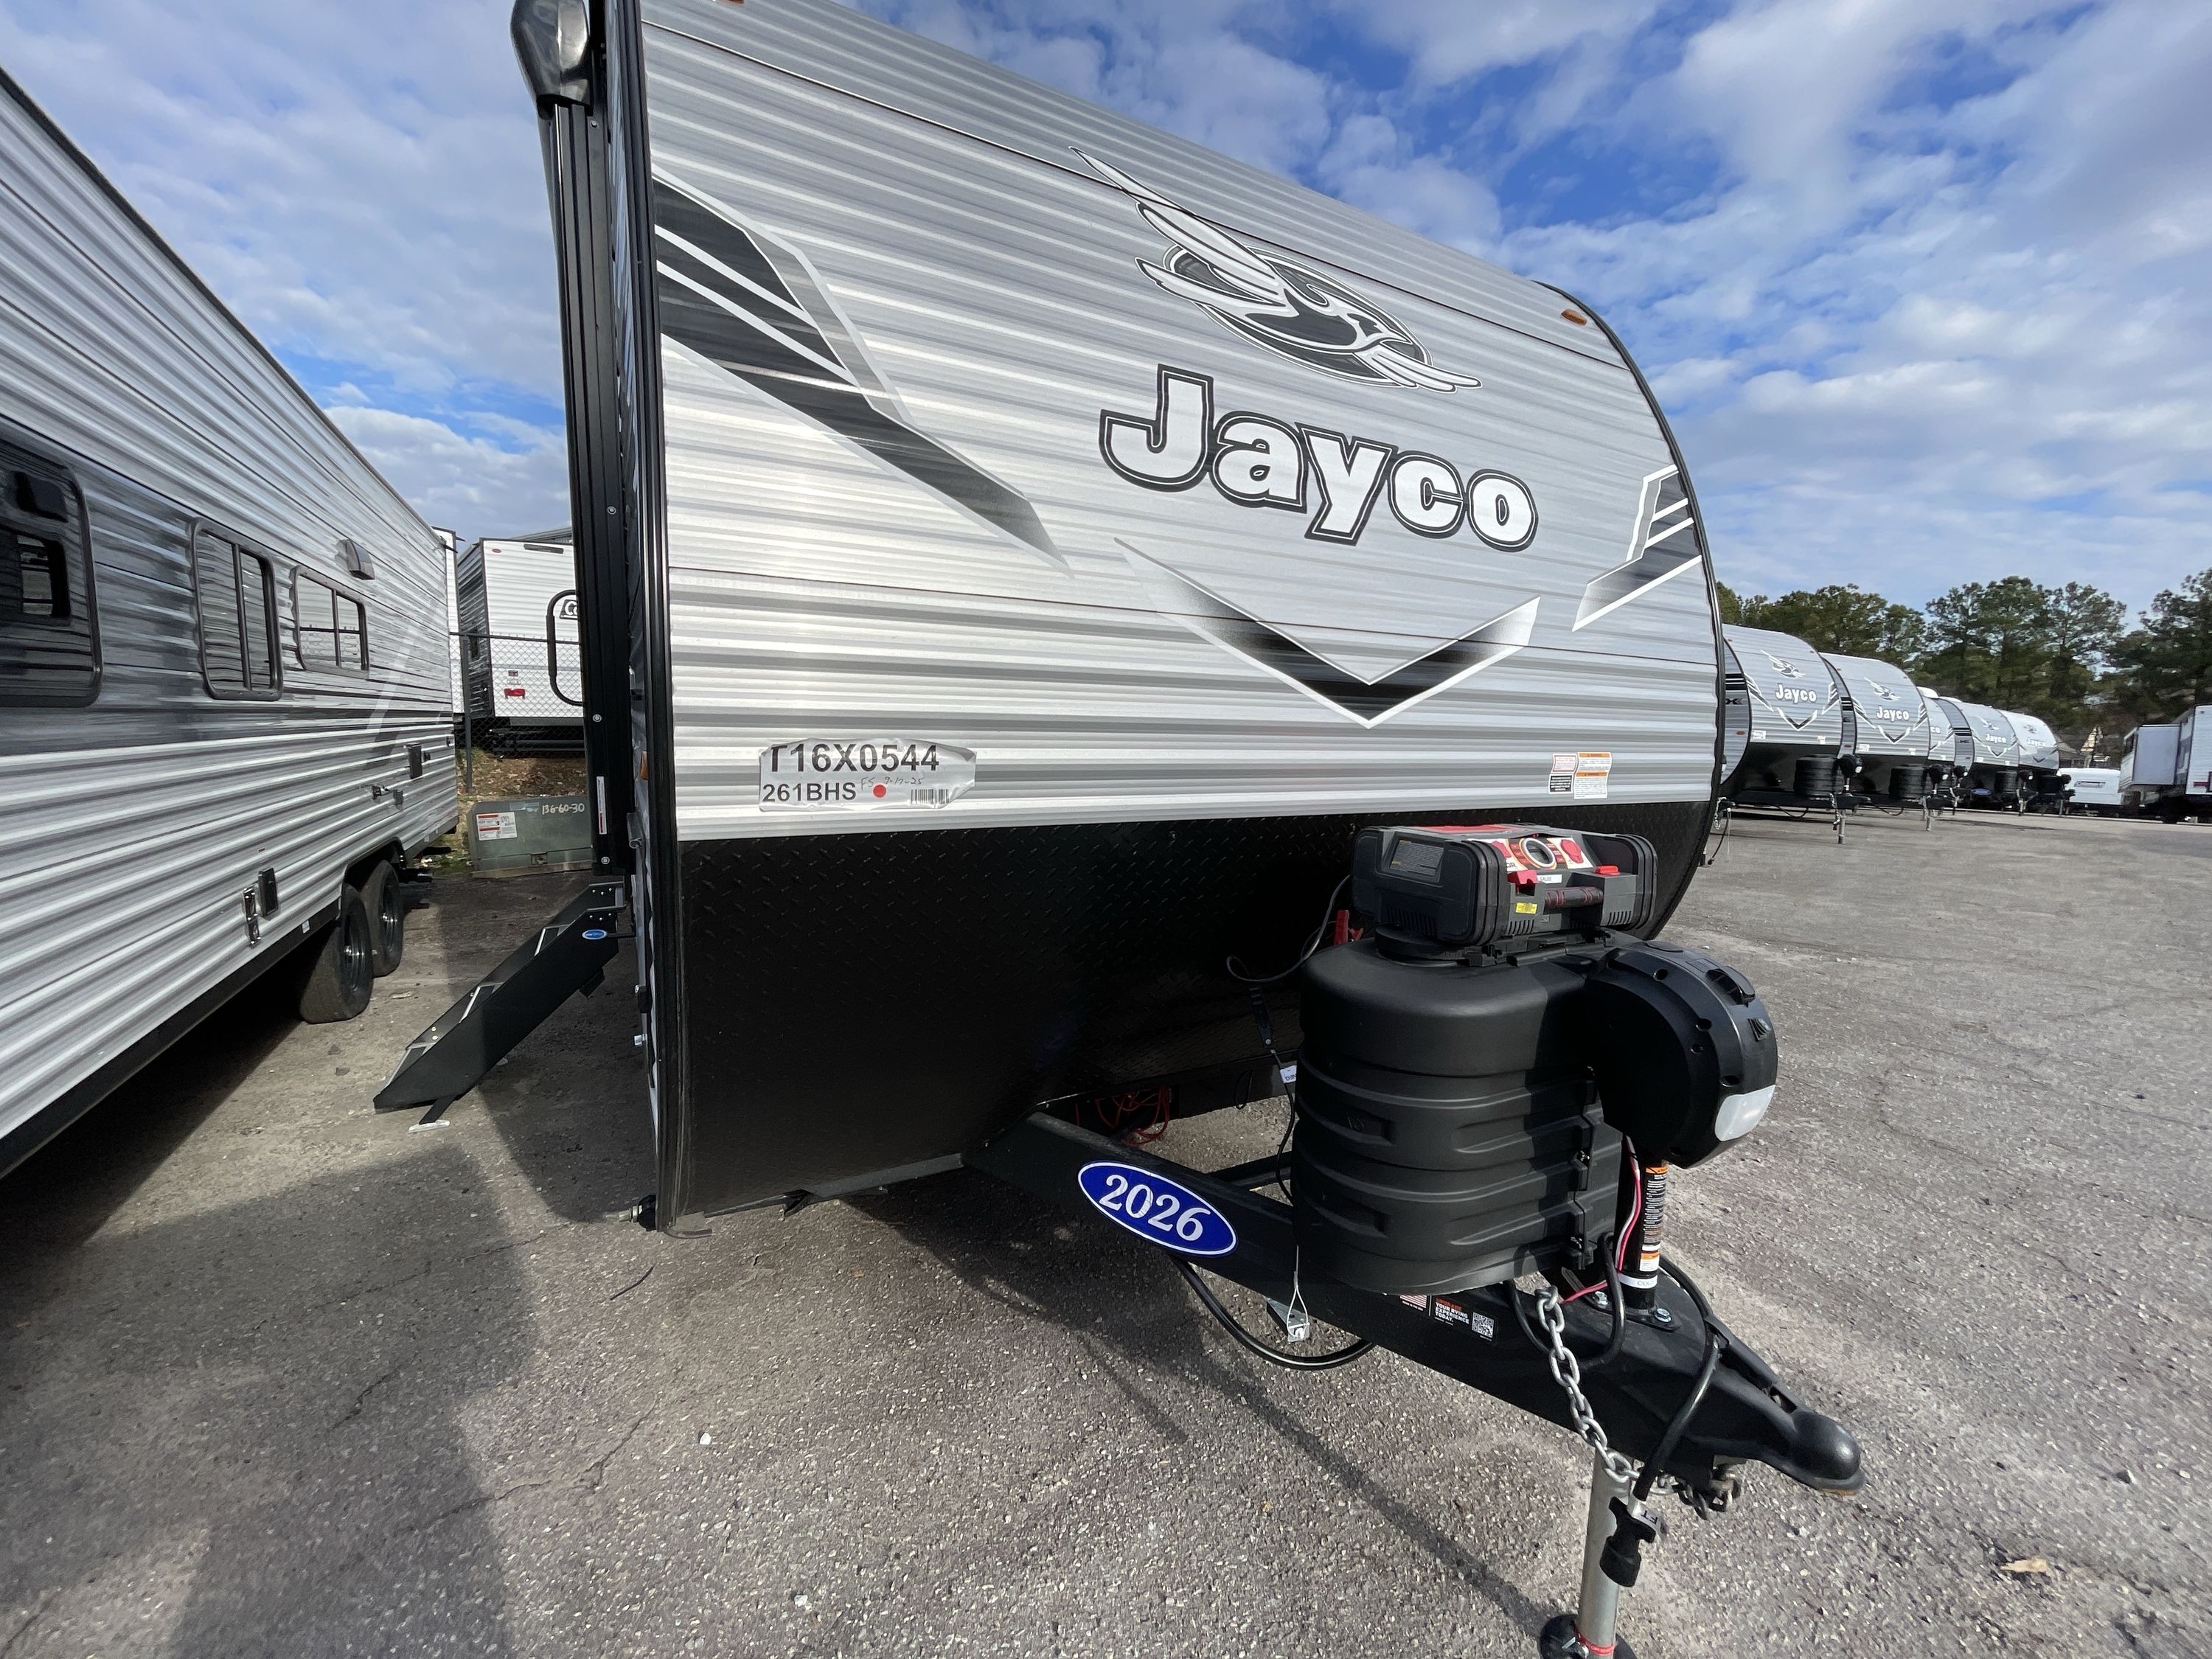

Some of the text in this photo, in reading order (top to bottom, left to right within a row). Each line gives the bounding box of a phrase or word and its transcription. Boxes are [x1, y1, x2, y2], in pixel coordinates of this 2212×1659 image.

[1099, 364, 1538, 552] Jayco
[1775, 683, 1817, 704] Jayco
[1877, 705, 1910, 722] Jayco
[1986, 733, 2006, 743] Jayco
[770, 743, 940, 772] T16X0544
[762, 782, 856, 802] 261BHS
[542, 803, 585, 815] 136-60-30
[1099, 1175, 1211, 1241] 2026
[1435, 1302, 1450, 1312] YOUR
[1435, 1307, 1470, 1324] EXPERIENCE
[1435, 1312, 1453, 1322] TODAY.
